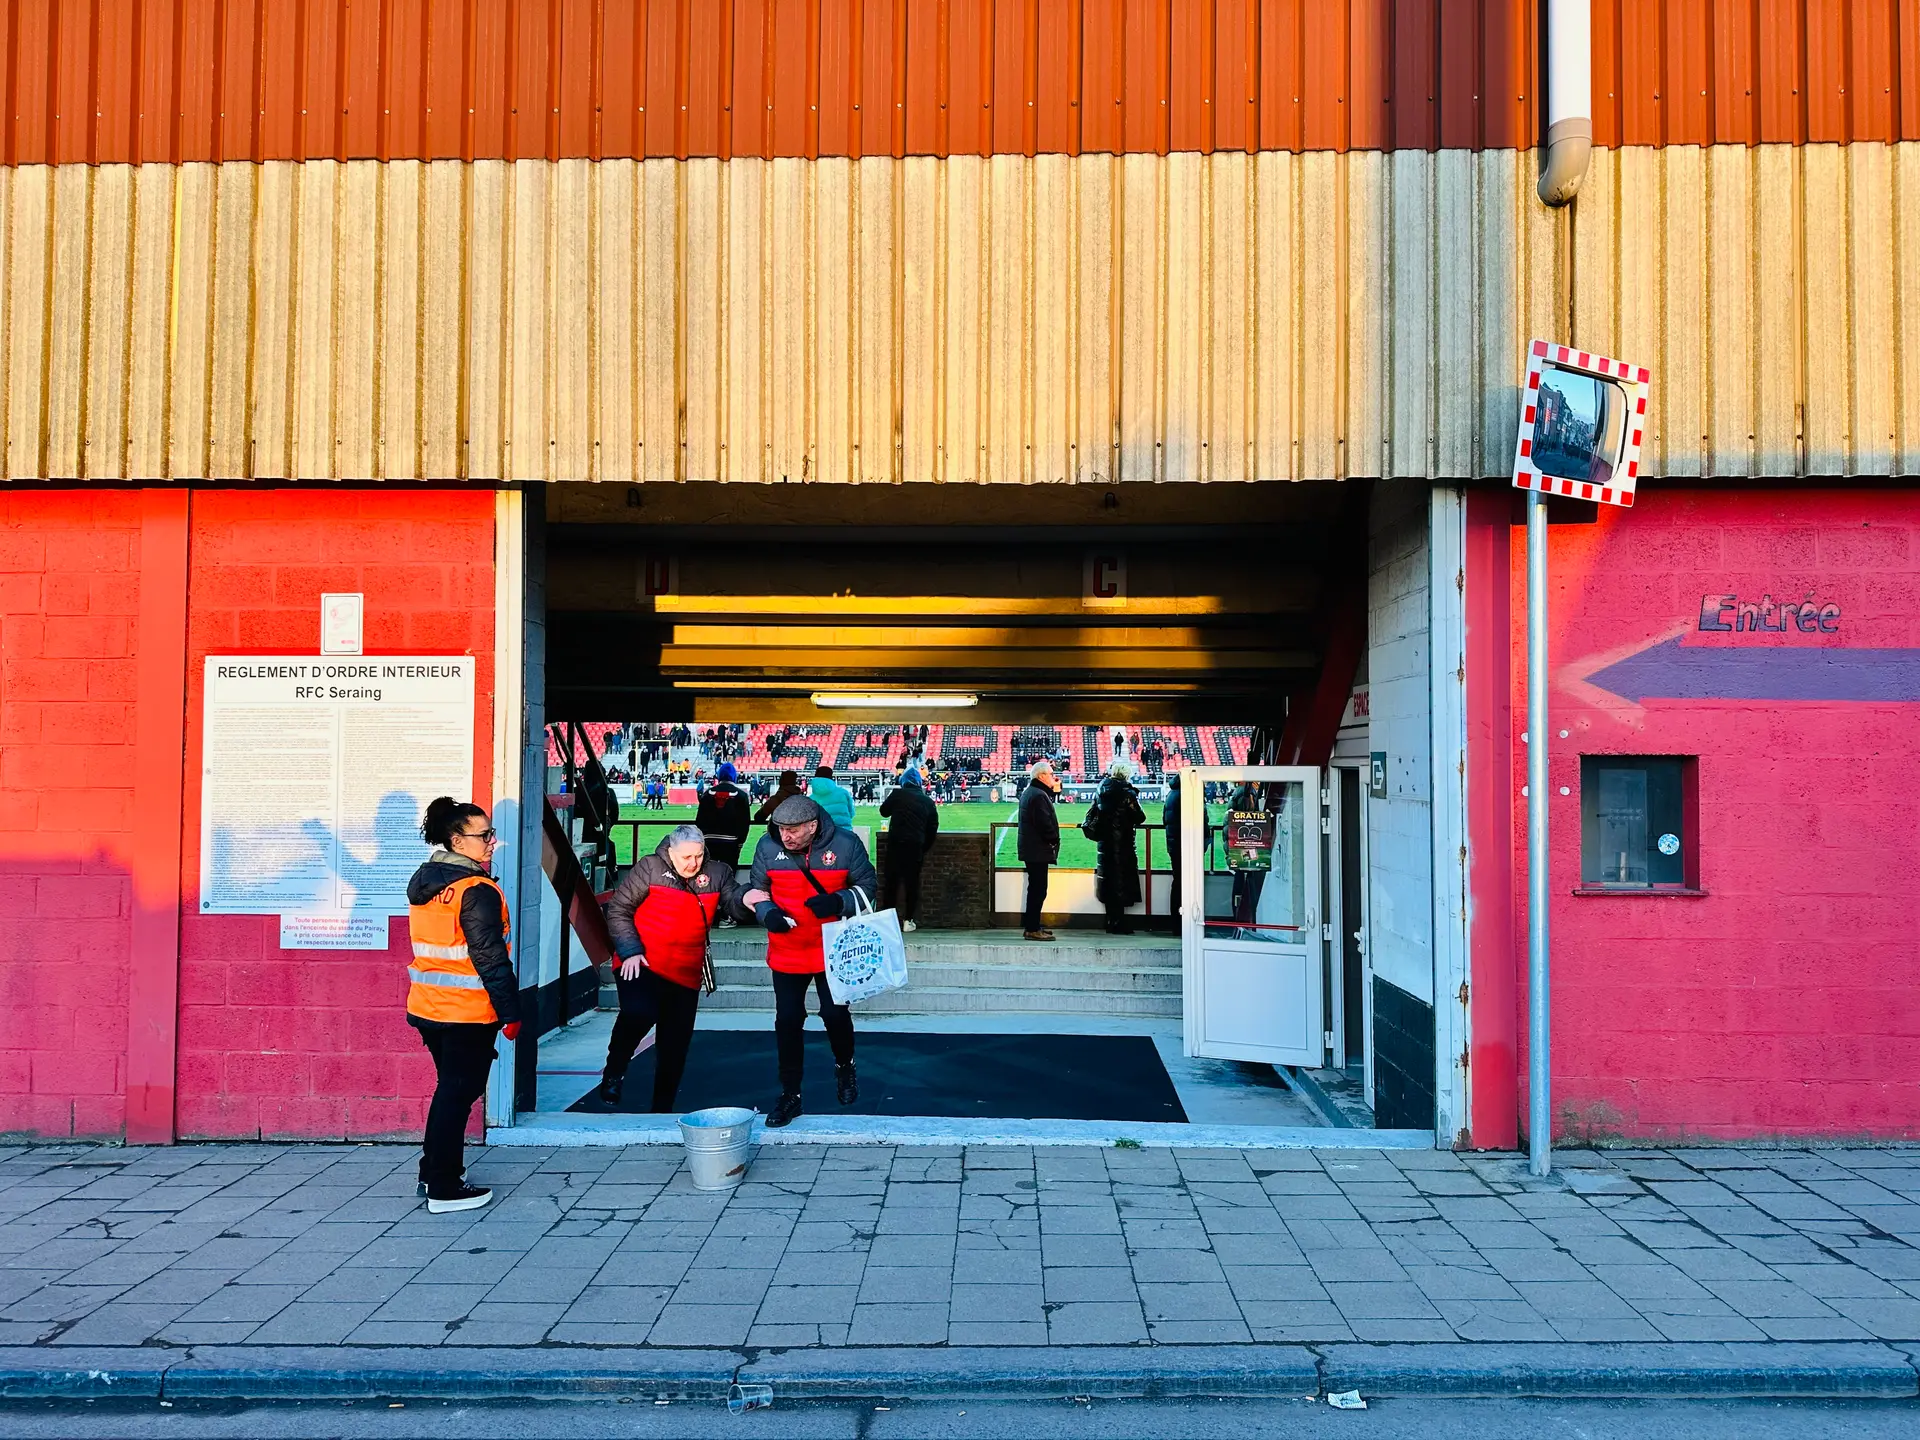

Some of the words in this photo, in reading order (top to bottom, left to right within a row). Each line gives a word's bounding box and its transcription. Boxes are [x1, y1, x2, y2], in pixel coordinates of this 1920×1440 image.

[1093, 556, 1117, 598] C
[1698, 589, 1841, 633] Entrée
[218, 666, 307, 678] REGLEMENT
[312, 666, 377, 678] D'ORDRE
[382, 666, 461, 678] INTERIEUR
[295, 686, 324, 698] RFC
[329, 686, 382, 701] Seraing
[841, 944, 874, 961] ACTION
